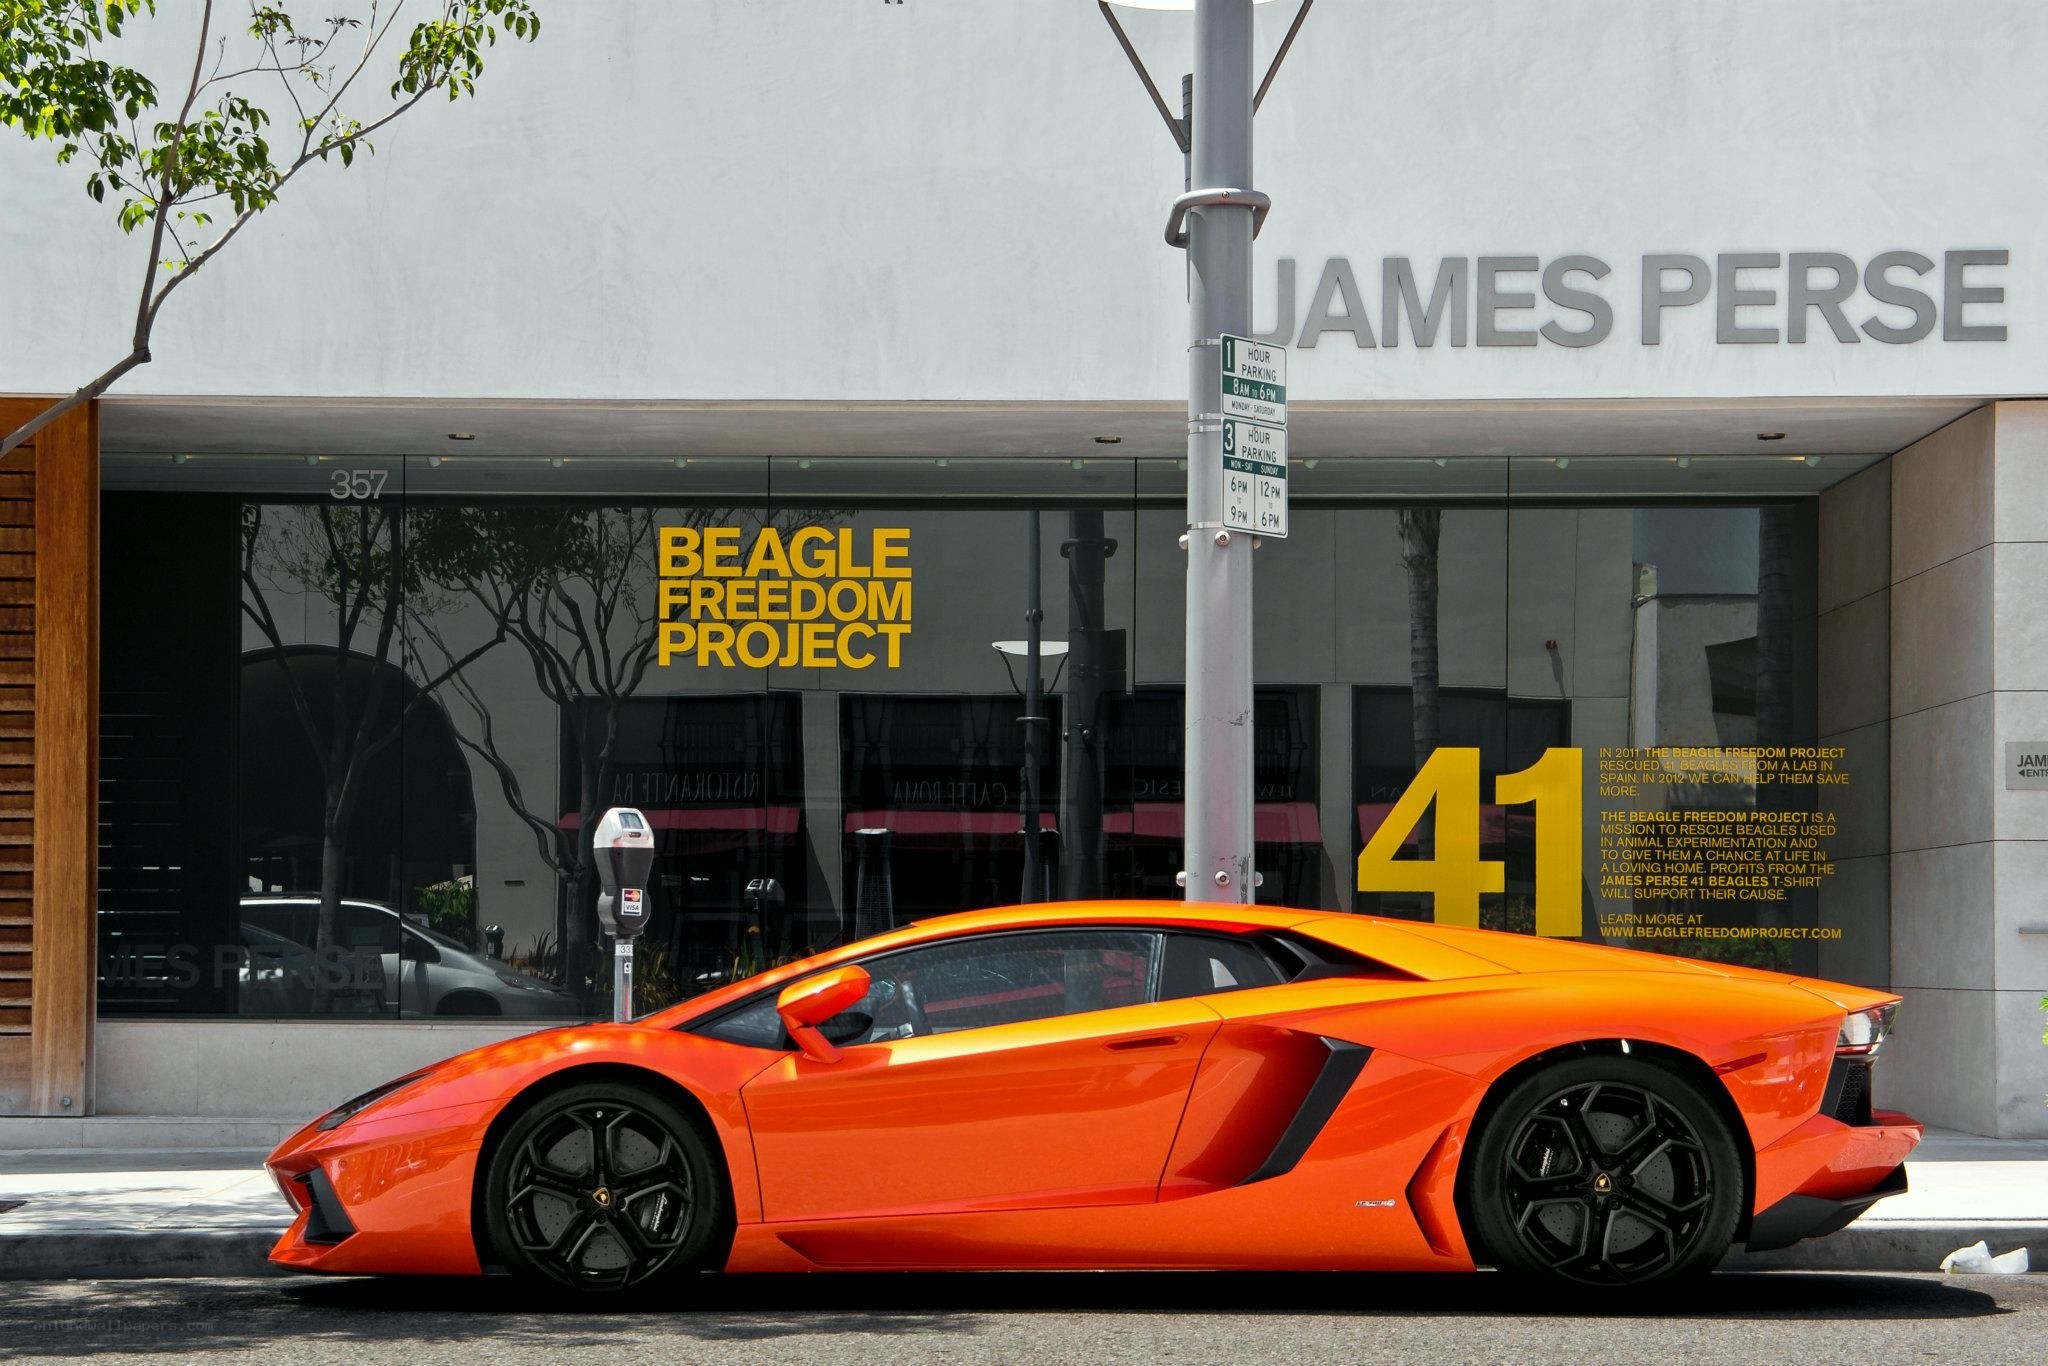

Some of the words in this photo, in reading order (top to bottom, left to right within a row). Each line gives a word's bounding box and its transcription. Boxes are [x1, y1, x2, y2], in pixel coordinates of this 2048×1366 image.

[1253, 255, 1614, 348] JAMES
[1642, 249, 2009, 345] PERSE
[1226, 341, 1231, 369] 1
[1248, 348, 1270, 363] HOUR
[1241, 364, 1277, 382] PARKING
[1224, 423, 1233, 451] 3
[1248, 429, 1270, 444] HOUR
[1242, 446, 1277, 463] PARKING
[1260, 464, 1279, 475] SUNDAY
[330, 469, 388, 499] 357
[658, 526, 912, 579] BEAGLE
[658, 579, 912, 621] FREEDOM
[657, 621, 912, 669] PROJECT
[1600, 747, 1611, 759] IN
[1615, 747, 1640, 759] 2011
[1644, 747, 1669, 759] THE
[1672, 747, 1722, 759] BEAGLE
[1725, 747, 1786, 759] FREEDOM
[1790, 747, 1845, 759] PROJECT
[1600, 760, 1660, 772] RESCUED
[1664, 760, 1674, 772] 41
[1680, 760, 1738, 772] BEAGLES
[1741, 760, 1778, 772] FROM
[1781, 760, 1790, 772] A
[1793, 760, 1817, 772] LAB
[1821, 760, 1833, 772] IN
[2017, 755, 2048, 768] JAM
[1600, 772, 1639, 784] SPAIN.
[1642, 772, 1654, 784] IN
[1658, 772, 1684, 784] 2012
[1689, 772, 1708, 784] WE
[1712, 772, 1739, 784] CAN
[1743, 772, 1775, 784] HELP
[1779, 772, 1813, 784] THEM
[1817, 772, 1848, 784] SAVE
[1600, 785, 1639, 797] MORE.
[1601, 811, 1626, 823] THE
[1629, 811, 1680, 823] BEAGLE
[1684, 811, 1747, 823] FREEDOM
[1750, 811, 1808, 823] PROJECT
[1812, 811, 1823, 823] IS
[1827, 811, 1836, 823] A
[1600, 824, 1655, 836] MISSION
[1660, 824, 1676, 836] TO
[1680, 824, 1731, 836] RESCUE
[1736, 824, 1797, 836] BEAGLES
[1801, 824, 1836, 836] USED
[1358, 748, 1582, 937] 41
[1600, 837, 1613, 848] IN
[1616, 837, 1661, 848] ANIMAL
[1667, 837, 1787, 848] EXPERIMENTATION
[1790, 837, 1817, 848] AND
[1601, 850, 1618, 861] TO
[1622, 850, 1650, 861] GIVE
[1656, 850, 1689, 861] THEM
[1694, 850, 1703, 861] A
[1706, 850, 1760, 861] CHANCE
[1766, 850, 1780, 861] AT
[1785, 850, 1808, 861] LIFE
[1814, 850, 1826, 861] IN
[1601, 862, 1610, 874] A
[1613, 862, 1660, 874] LOVING
[1664, 862, 1706, 874] HOME.
[1710, 862, 1764, 874] PROFITS
[1768, 862, 1806, 874] FROM
[1811, 862, 1835, 874] THE
[1601, 875, 1642, 886] JAMES
[1645, 875, 1687, 886] PERSE
[1690, 875, 1704, 886] 41
[1709, 875, 1769, 886] BEAGLES
[1773, 875, 1822, 886] T-SHIRT
[1600, 887, 1631, 900] WILL
[1634, 887, 1695, 900] SUPPORT
[1700, 887, 1736, 900] THEIR
[1739, 887, 1787, 900] CAUSE.
[1600, 913, 1642, 925] LEARN
[1646, 913, 1683, 925] MORE
[1687, 913, 1703, 925] AT
[1600, 926, 1842, 939] WWW.BEAGLEFREEDOMPROJECT.COM
[97, 943, 200, 990] MES
